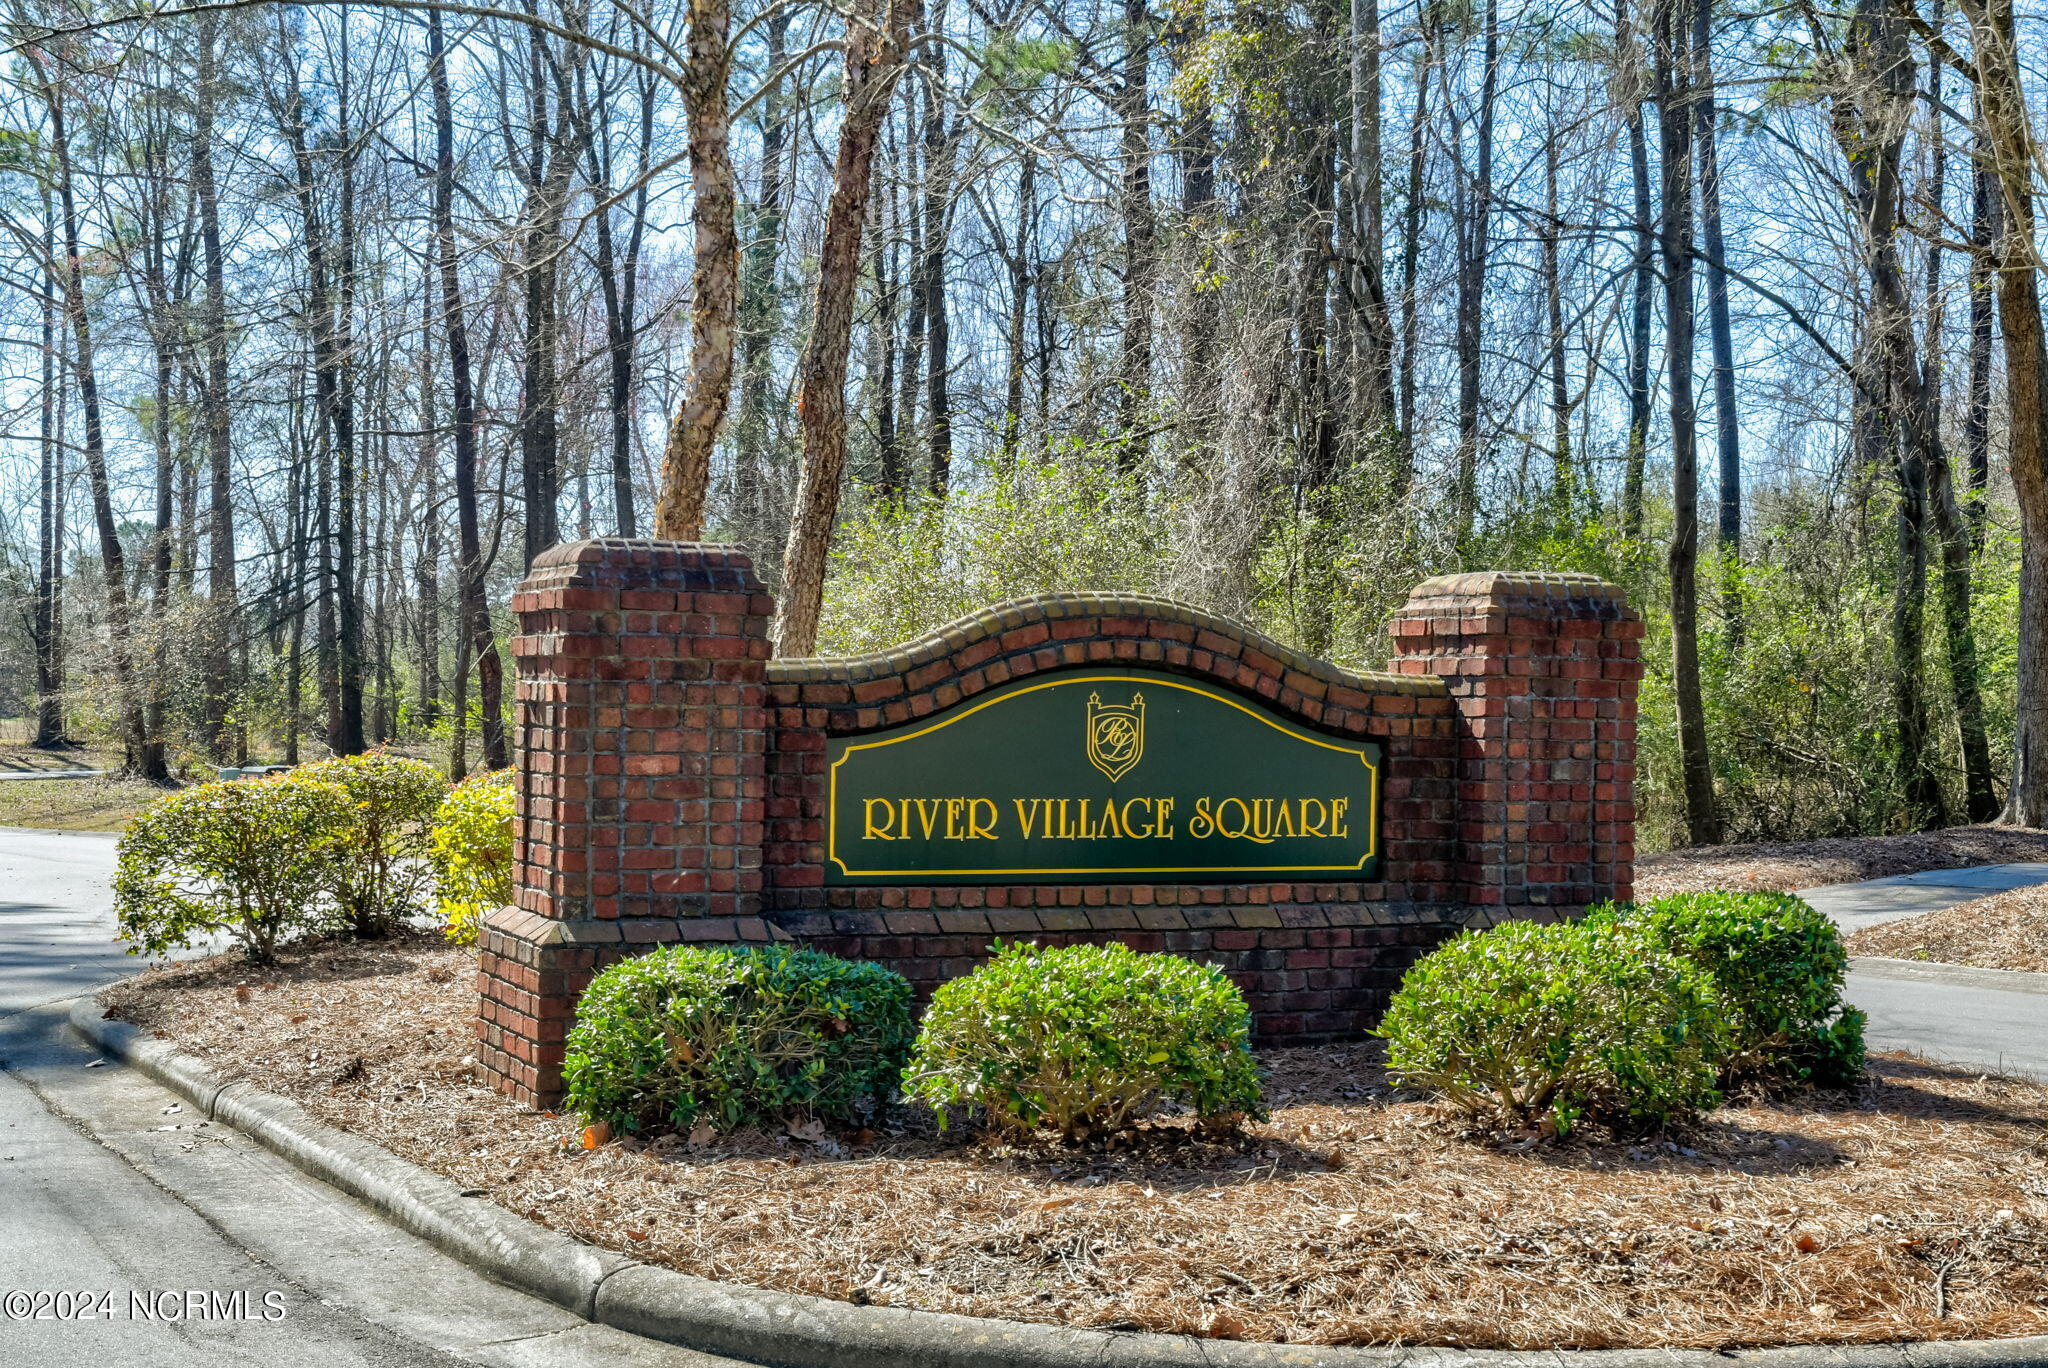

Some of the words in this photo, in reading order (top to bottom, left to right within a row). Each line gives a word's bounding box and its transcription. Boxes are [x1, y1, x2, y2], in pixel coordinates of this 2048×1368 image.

[862, 797, 999, 841] RIVER
[1013, 796, 1175, 840] VILLAGE
[1189, 796, 1349, 844] SQUARE
